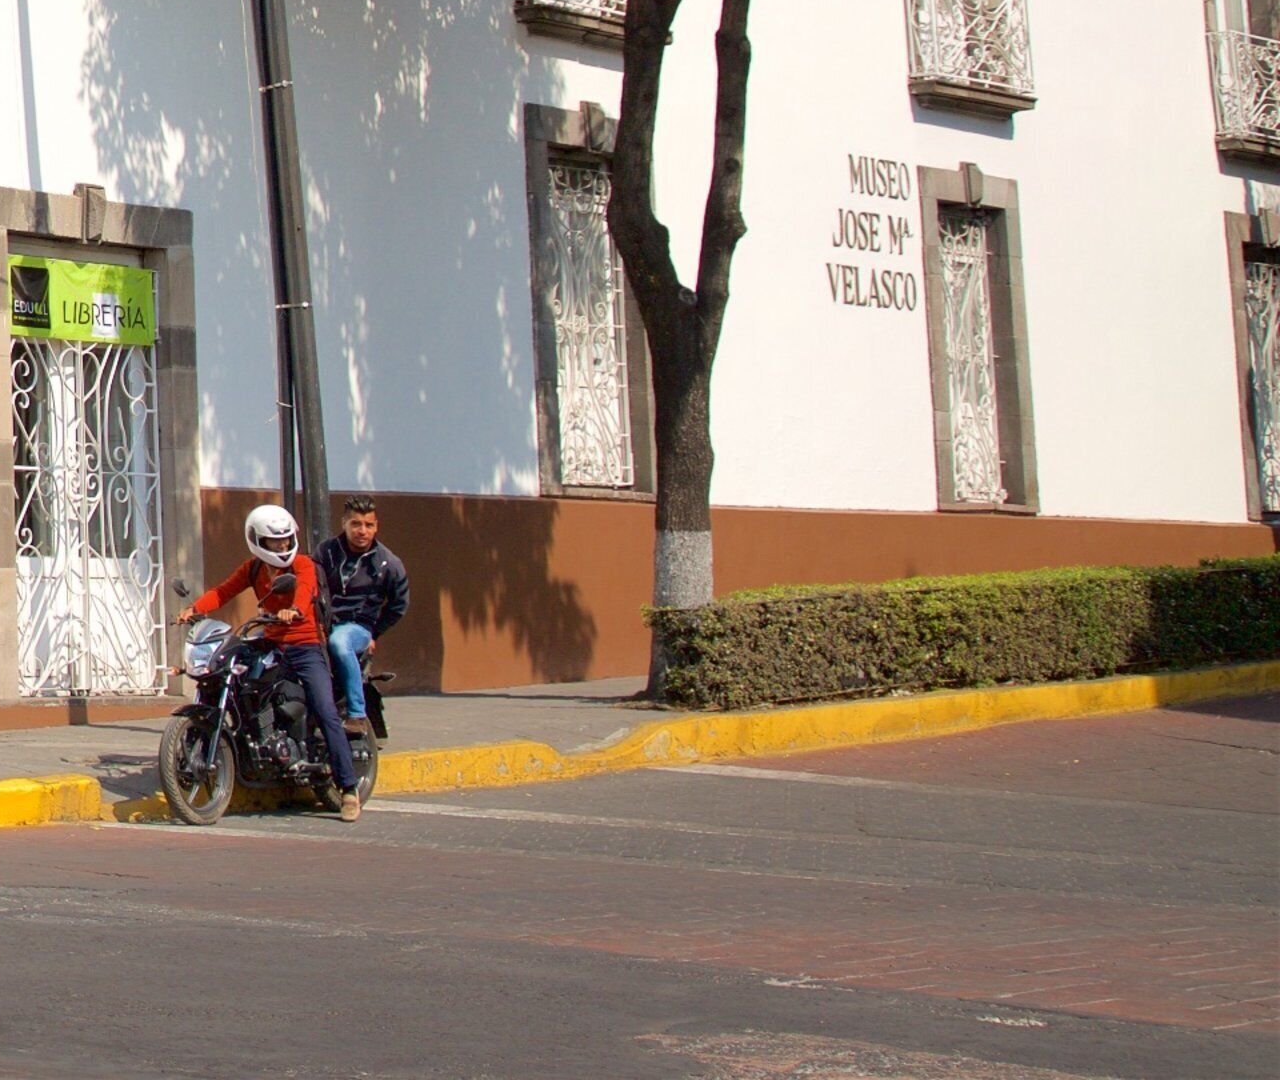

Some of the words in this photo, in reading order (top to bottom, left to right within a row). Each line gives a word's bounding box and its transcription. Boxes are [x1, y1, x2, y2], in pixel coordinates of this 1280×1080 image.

[848, 153, 910, 201] MUSEO
[832, 208, 881, 253] JOSE
[826, 263, 917, 311] VELASCO
[62, 298, 146, 330] LIBRERÍA
